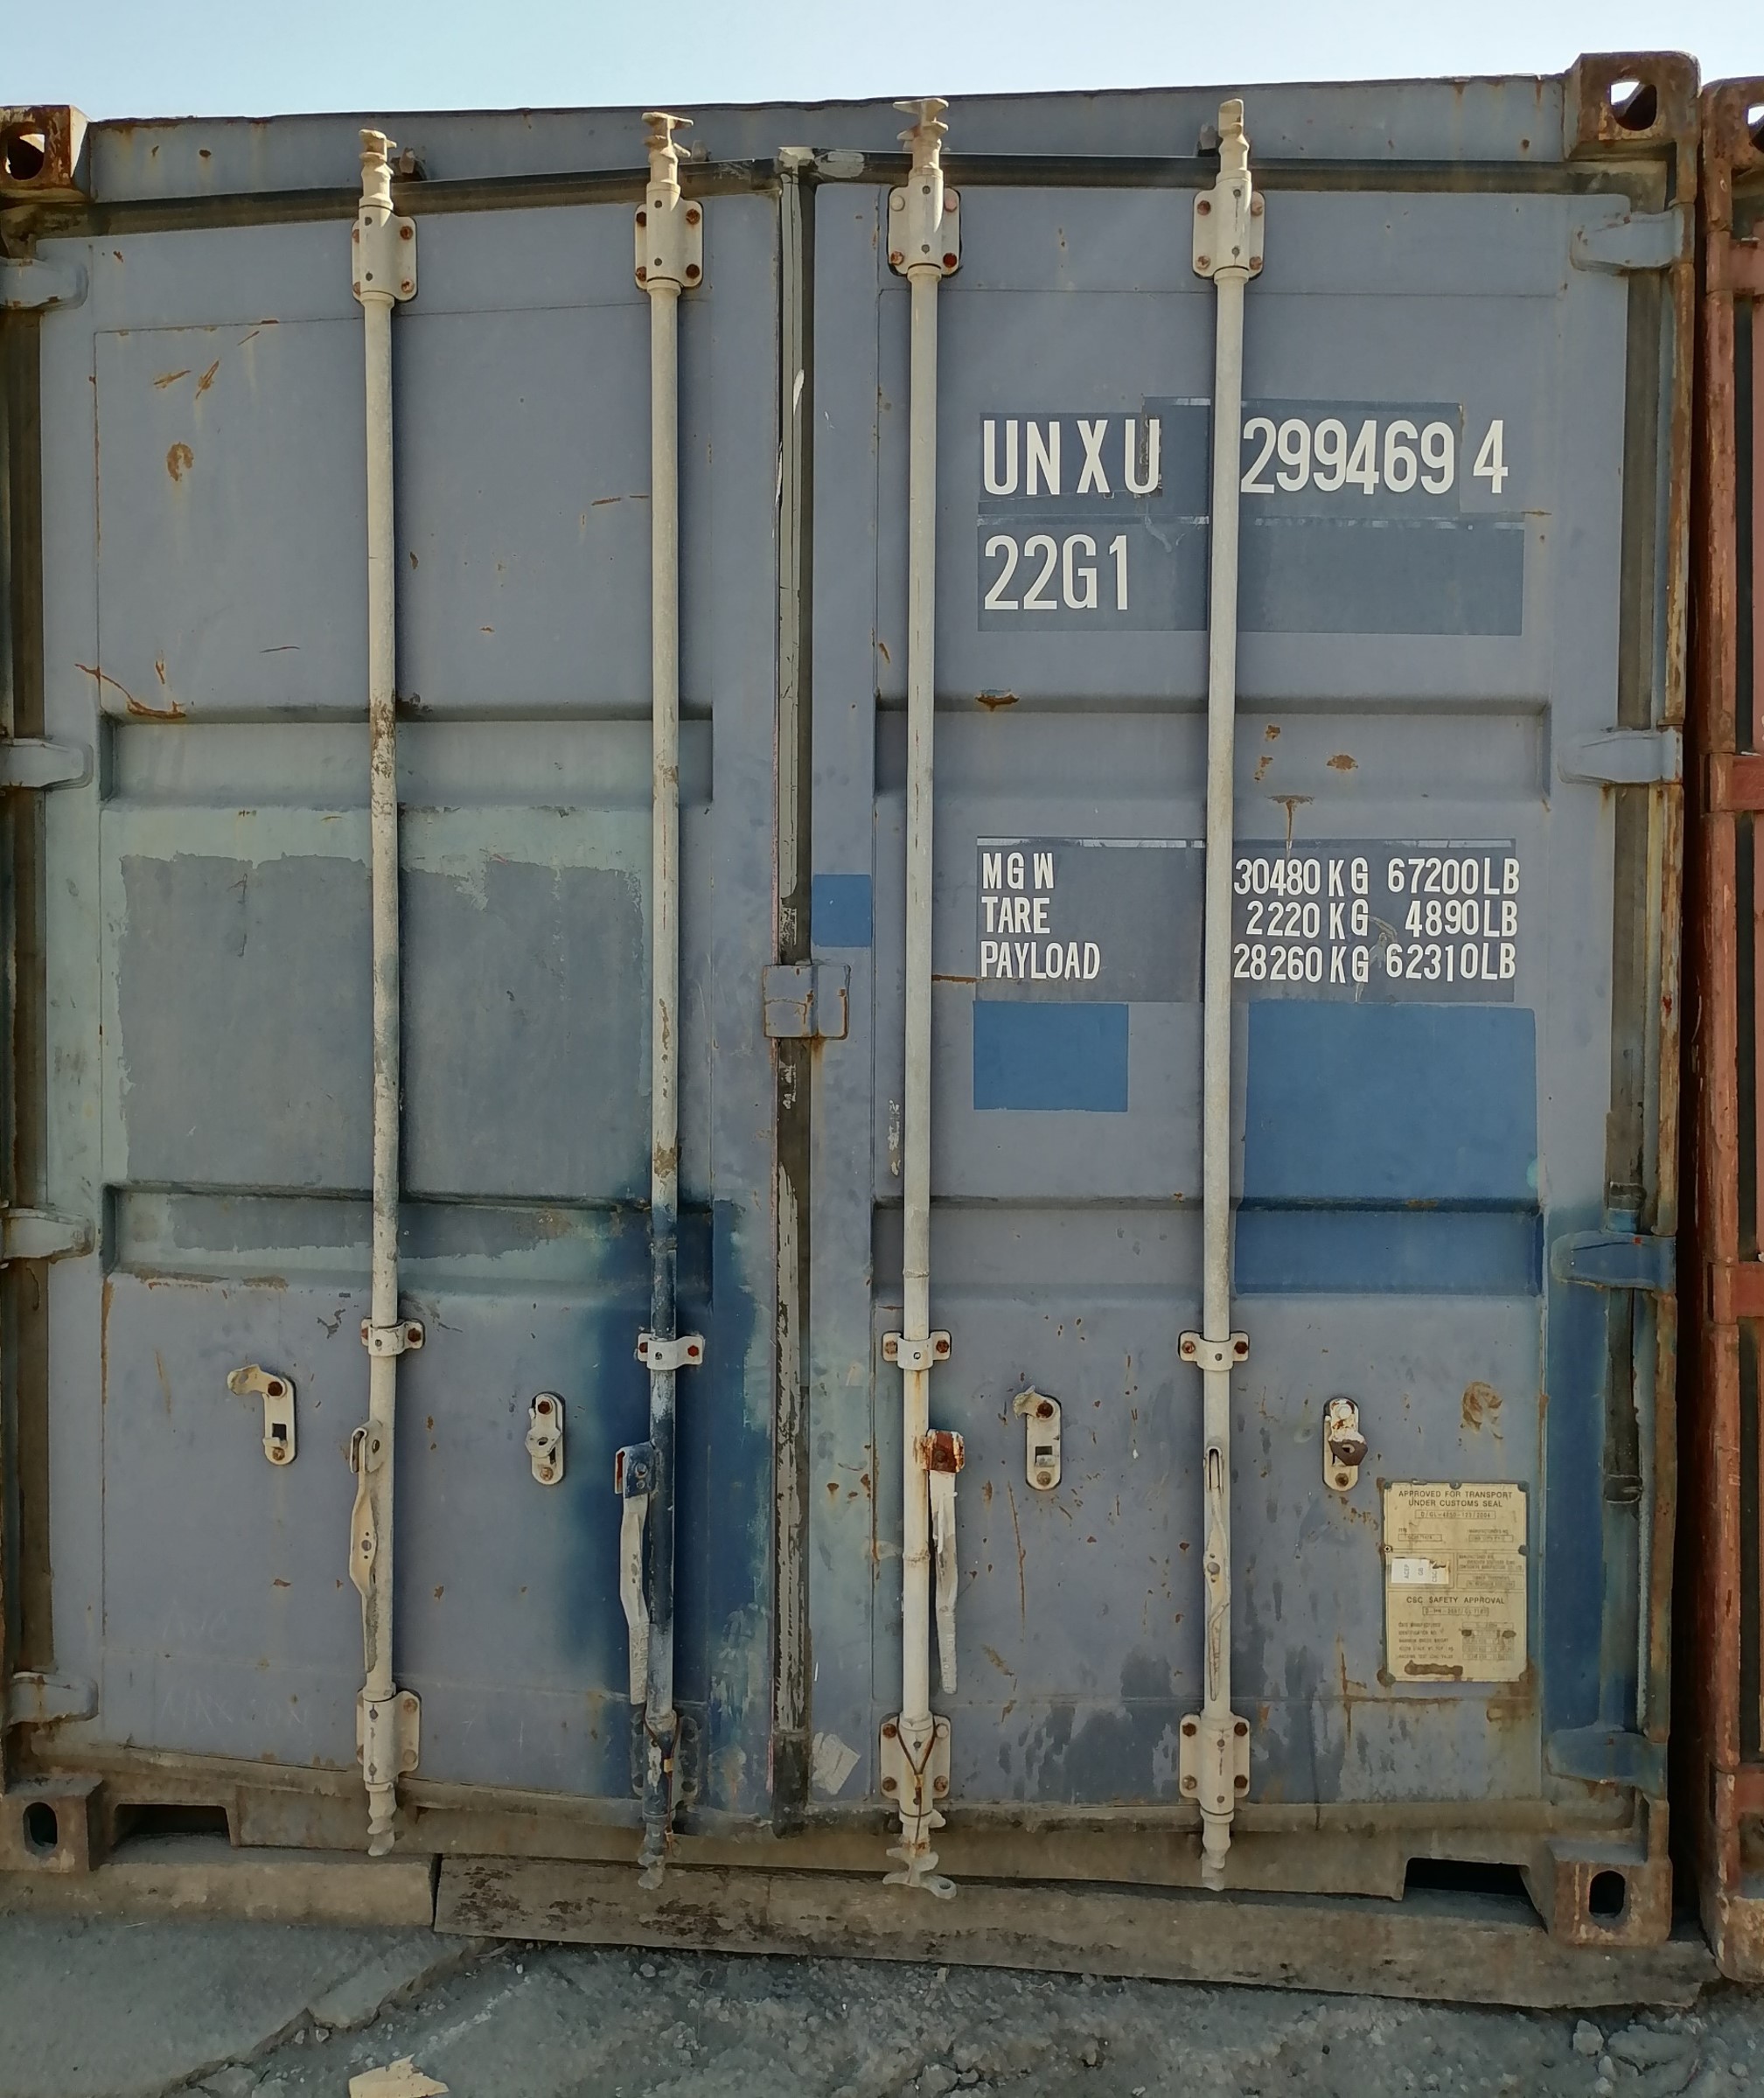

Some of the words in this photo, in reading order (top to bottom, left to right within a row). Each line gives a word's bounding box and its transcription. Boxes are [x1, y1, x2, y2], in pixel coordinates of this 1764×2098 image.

[983, 419, 1161, 496] UNXU
[1240, 417, 1455, 495] 299469
[1473, 419, 1509, 494] 4
[984, 533, 1128, 610] 22G1
[980, 896, 1050, 935] TARE
[980, 940, 1100, 980] PAYLOAD
[1440, 1499, 1479, 1508] CUSTOMS
[1465, 1490, 1513, 1499] TRANSPORT
[1464, 1596, 1505, 1605] APPROVAL
